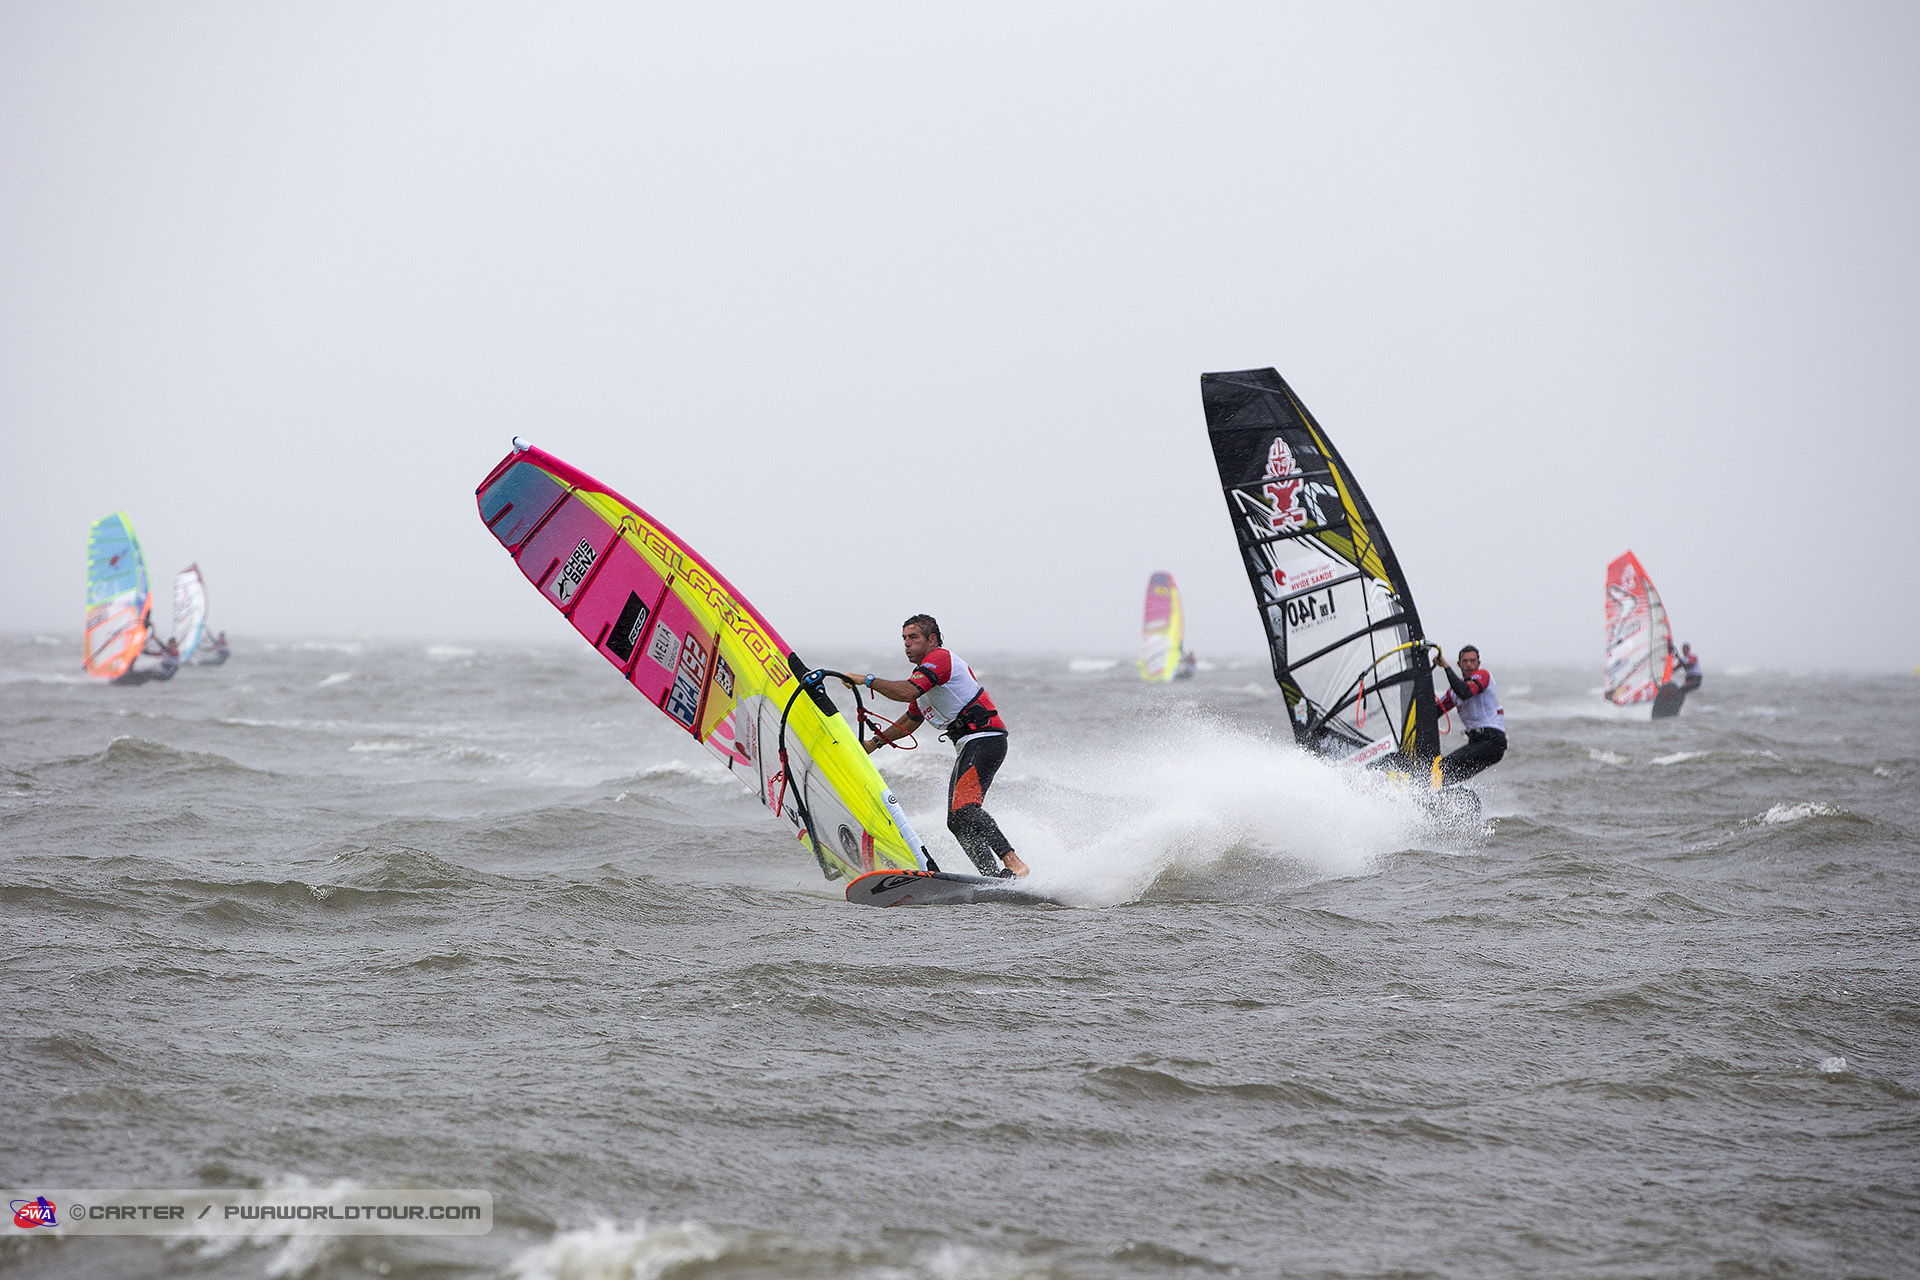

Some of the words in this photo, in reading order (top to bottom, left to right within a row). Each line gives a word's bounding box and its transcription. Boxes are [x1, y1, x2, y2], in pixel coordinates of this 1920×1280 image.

[563, 539, 591, 576] CHRIS
[572, 550, 598, 585] BENZ
[1311, 571, 1332, 584] SANDE
